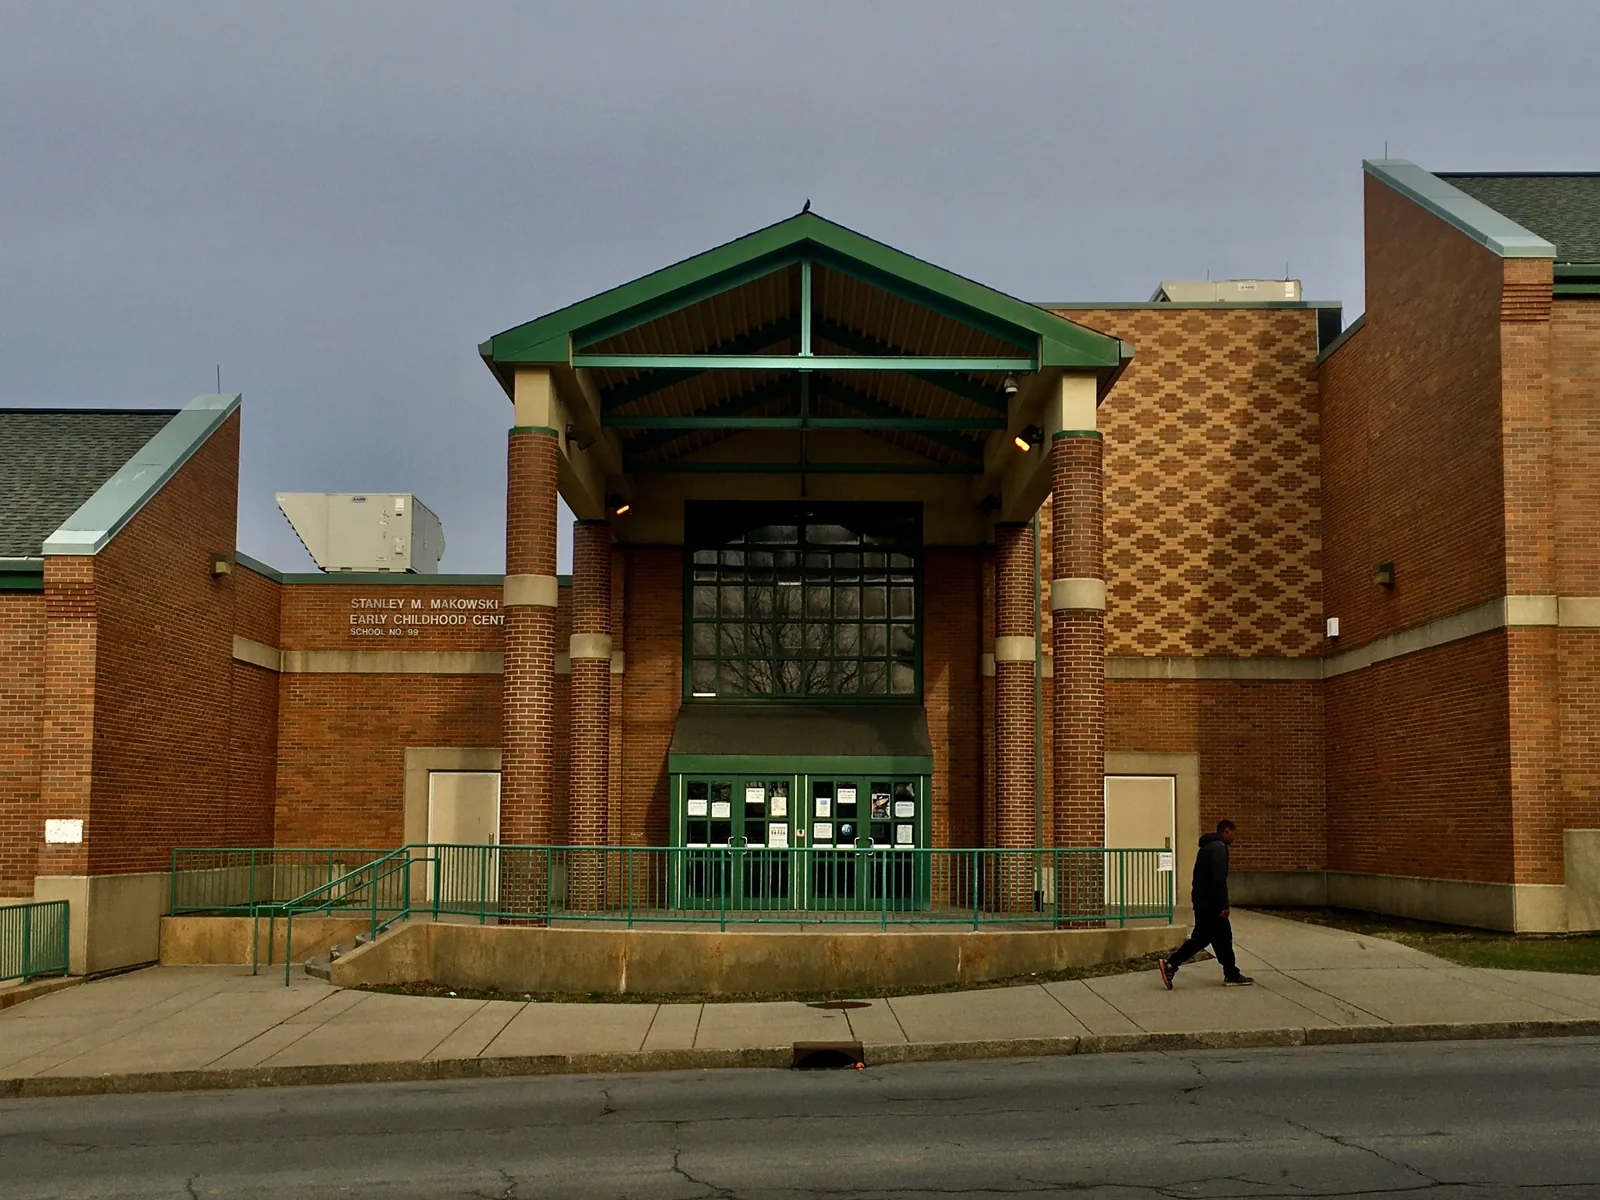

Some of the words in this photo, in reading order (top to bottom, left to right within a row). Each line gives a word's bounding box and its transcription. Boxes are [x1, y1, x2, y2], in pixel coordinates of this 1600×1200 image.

[351, 598, 405, 609] STANLEY
[411, 599, 424, 609] M.
[430, 599, 499, 610] MAKOWSKI
[350, 614, 387, 625] EARLY
[393, 614, 467, 625] CHILDHOOD
[350, 628, 385, 636] SCHOOL
[389, 628, 403, 636] NO.
[408, 628, 419, 636] 99
